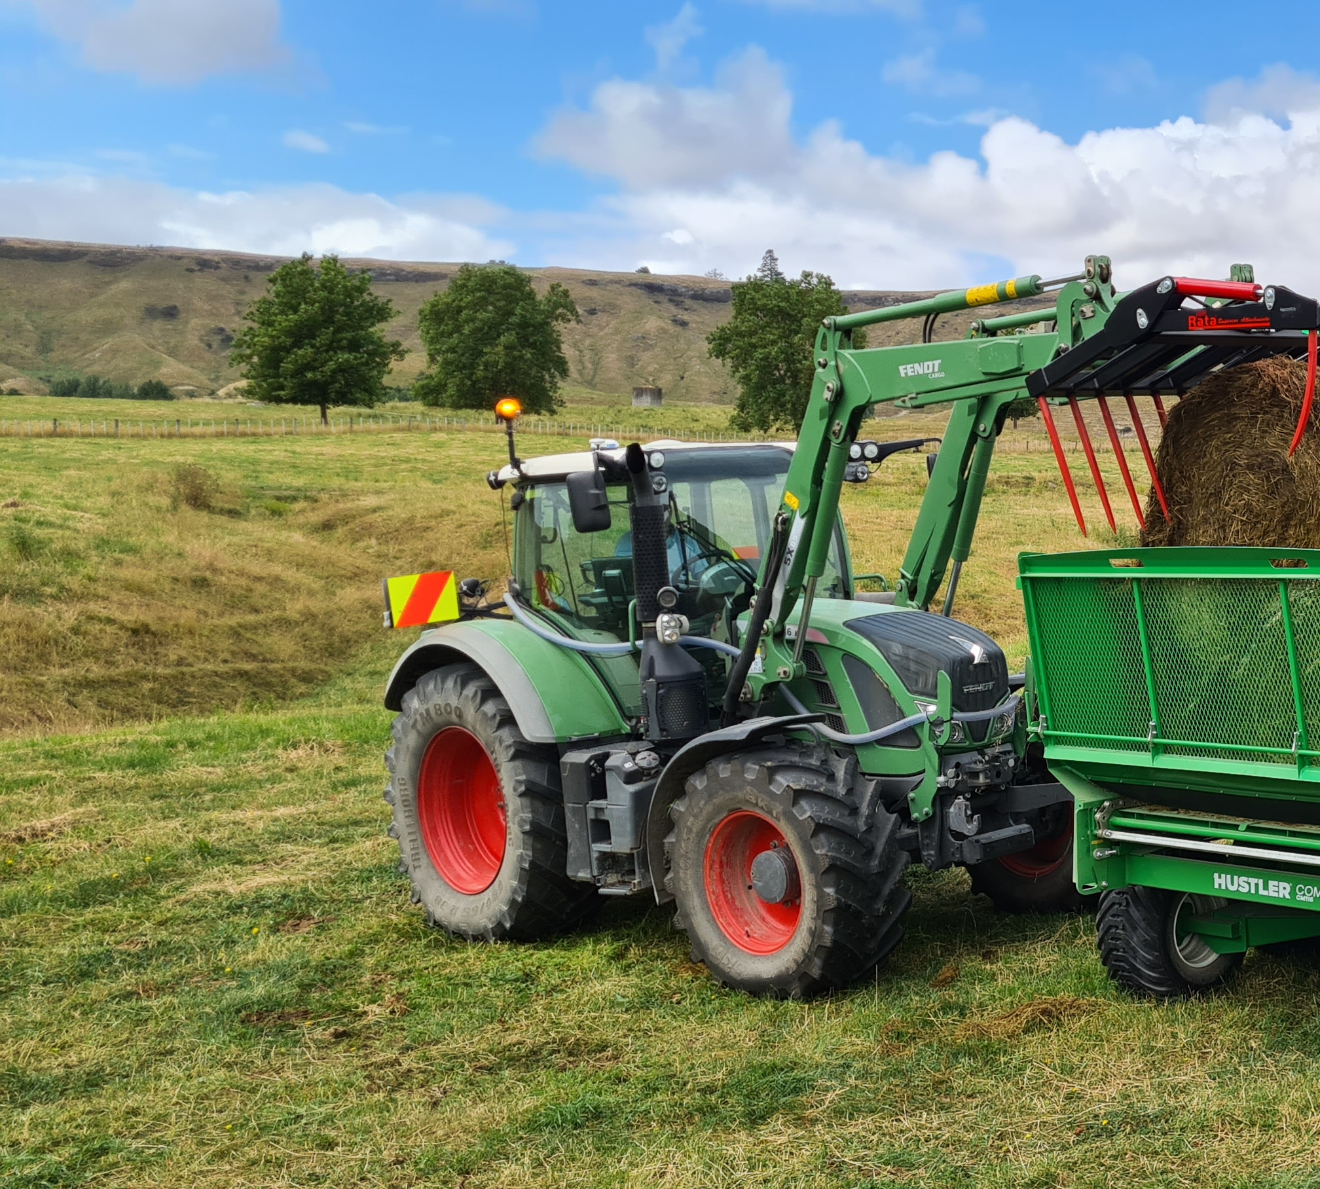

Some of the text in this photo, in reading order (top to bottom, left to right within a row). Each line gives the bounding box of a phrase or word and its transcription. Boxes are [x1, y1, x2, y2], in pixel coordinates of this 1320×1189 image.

[1188, 315, 1217, 327] Rata
[898, 359, 941, 377] FENDT
[928, 371, 945, 379] CARGO
[962, 681, 996, 694] FENDT
[397, 777, 422, 872] TRELLEBORG
[1213, 872, 1291, 899] HUSTLER
